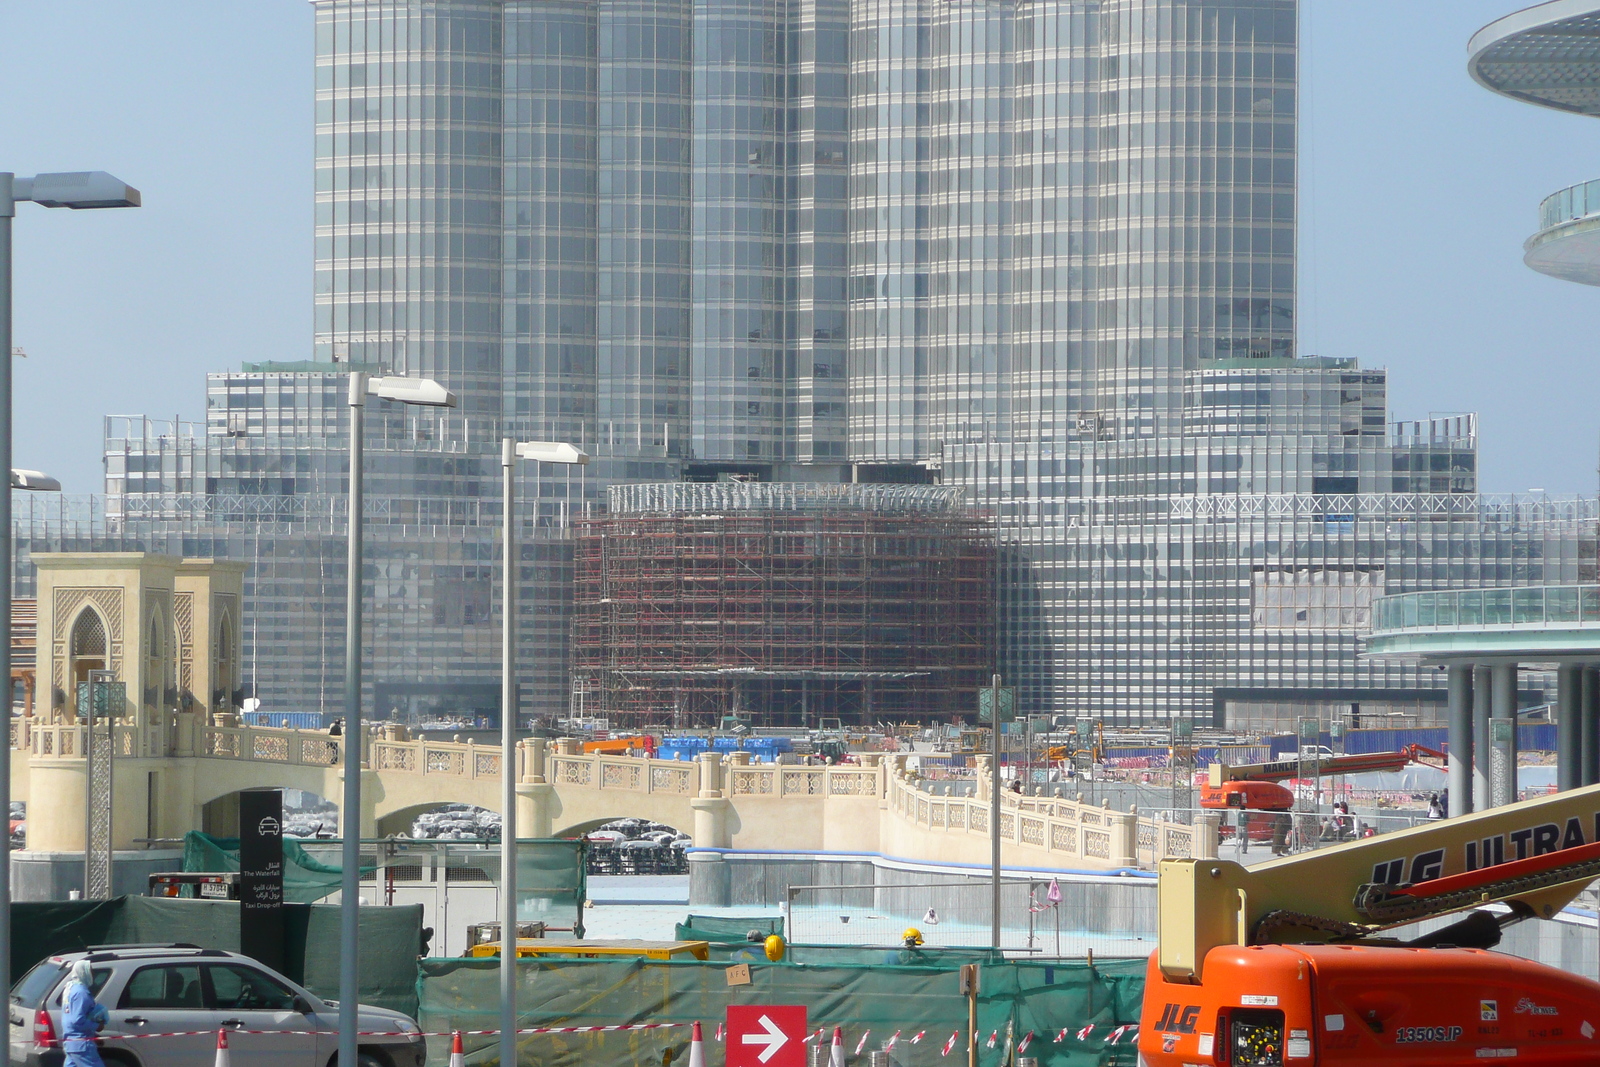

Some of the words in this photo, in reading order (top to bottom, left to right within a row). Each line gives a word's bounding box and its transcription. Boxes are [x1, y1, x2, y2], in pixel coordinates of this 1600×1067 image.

[1263, 762, 1302, 773] MANLIF
[1465, 816, 1586, 872] ULTRA
[1153, 1003, 1201, 1034] JLG
[1396, 1026, 1462, 1043] 1350SJP
